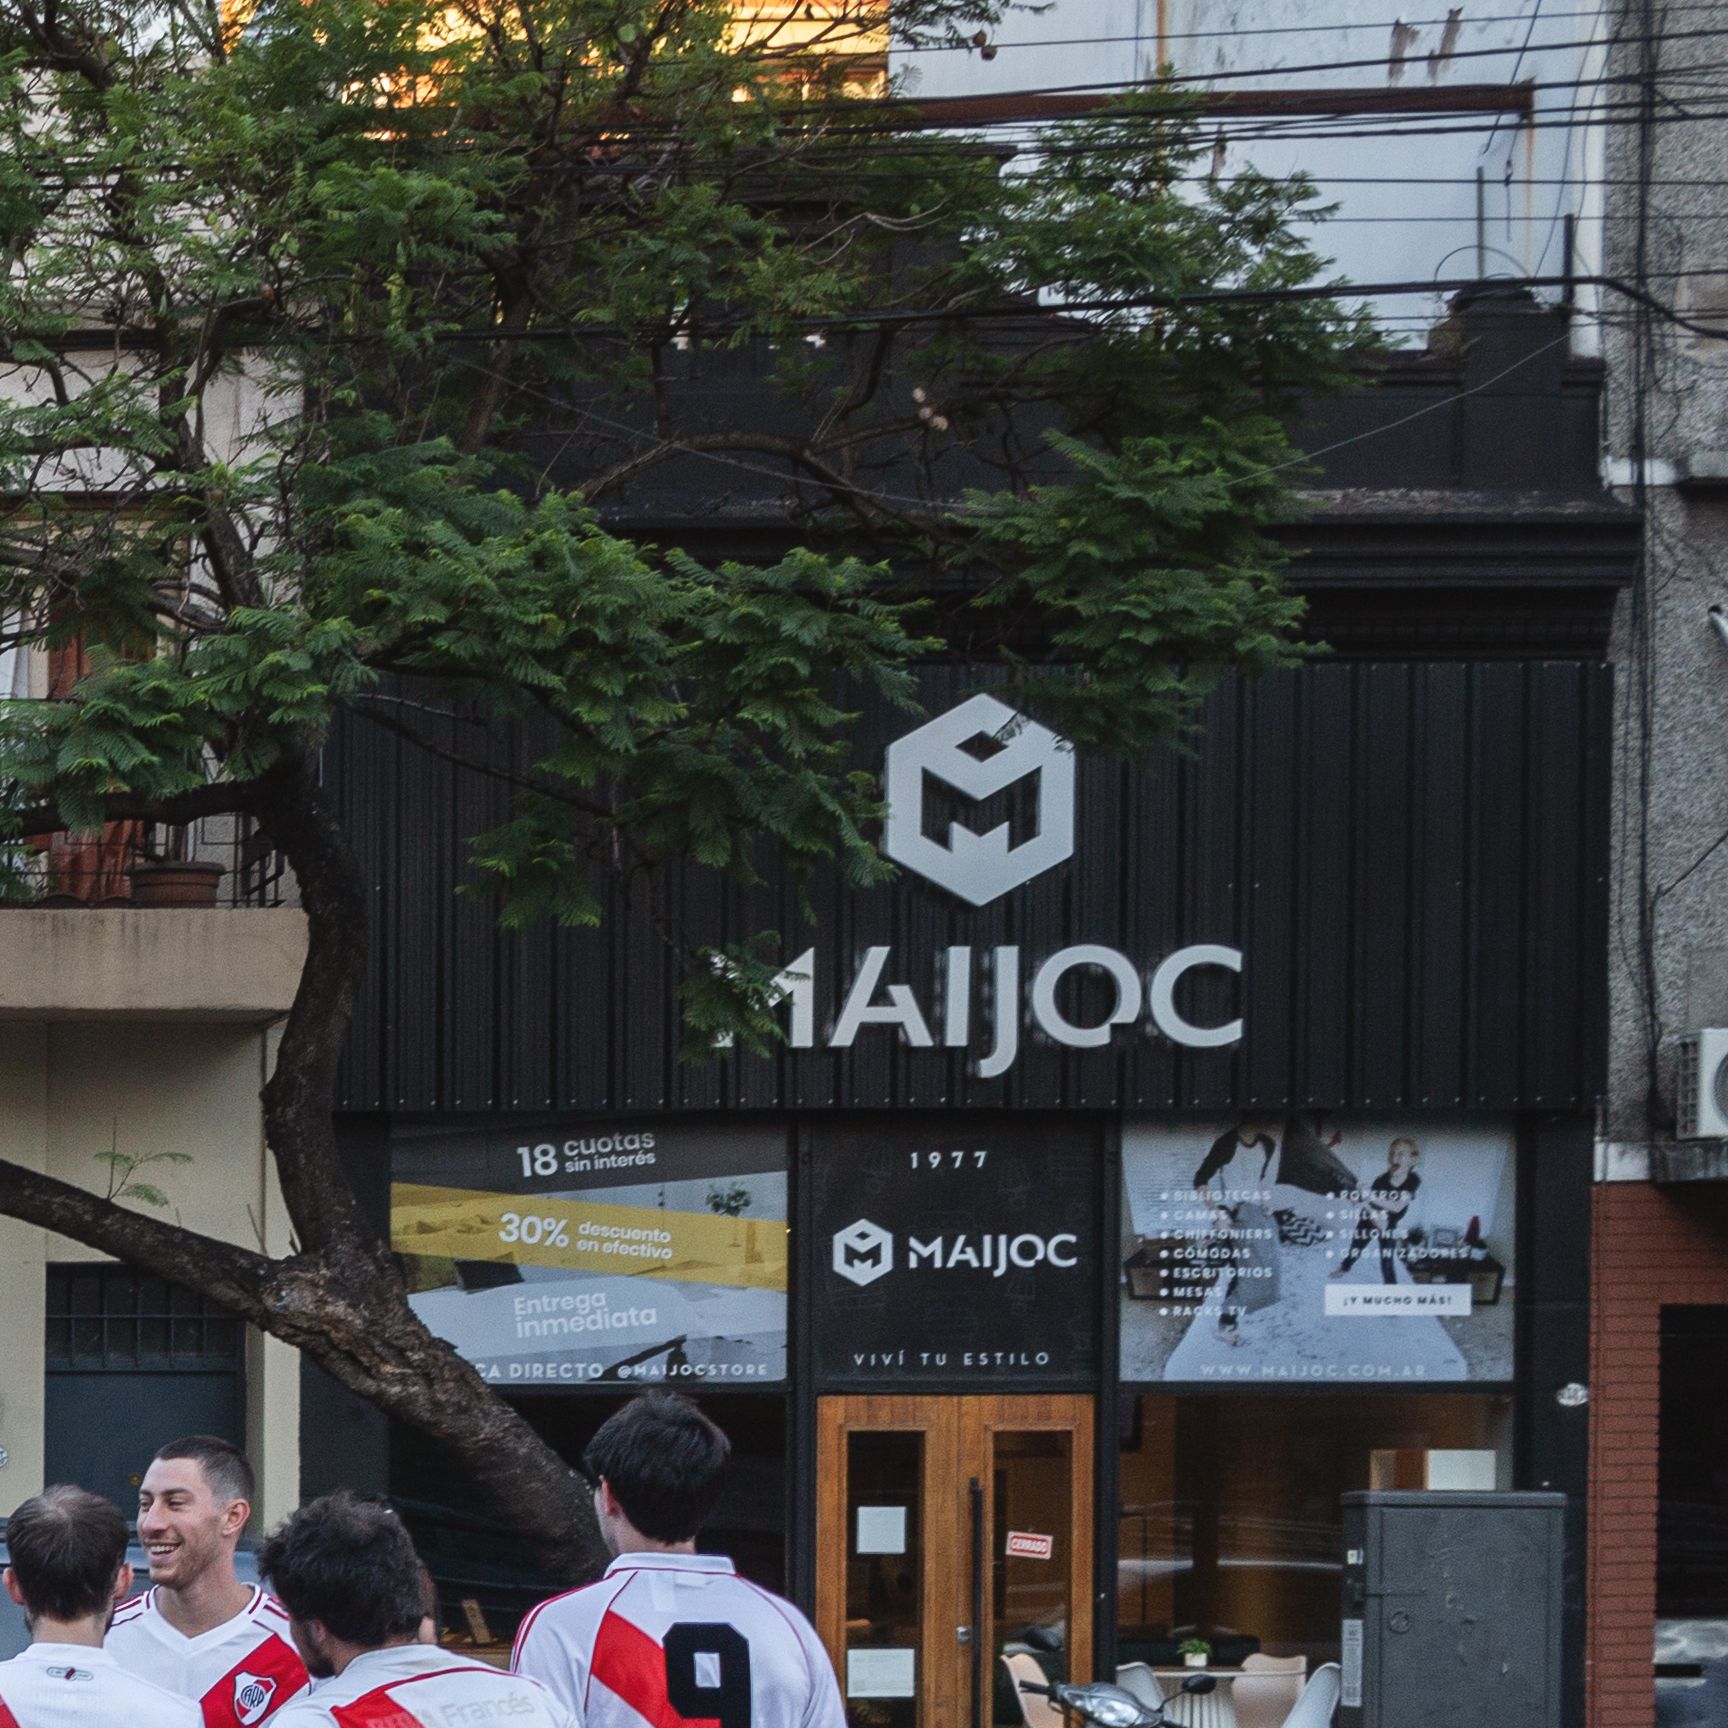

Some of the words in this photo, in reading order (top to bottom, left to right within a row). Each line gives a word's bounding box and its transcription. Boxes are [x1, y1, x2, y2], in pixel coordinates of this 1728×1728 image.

[517, 1144, 558, 1178] 18
[563, 1132, 656, 1158] cuotas
[564, 1158, 590, 1174] sin
[593, 1150, 656, 1171] interés
[910, 1151, 987, 1169] 1977
[1173, 1189, 1272, 1201] BIBLIOTECAS
[1339, 1190, 1410, 1201] ROPEROS
[1174, 1209, 1228, 1221] CAMAS
[1339, 1209, 1389, 1220] SILLAS
[498, 1211, 570, 1249] 30%
[578, 1220, 672, 1244] descuento
[576, 1238, 599, 1253] en
[601, 1240, 673, 1260] efectivo
[908, 1233, 1078, 1278] MAIJOC
[1172, 1266, 1273, 1279] ESCRITORIOS
[1172, 1286, 1224, 1298] MESAS
[1362, 1295, 1413, 1305] MUCHO
[1417, 1293, 1452, 1305] MÁS!
[514, 1291, 607, 1317] Entrega
[1228, 1305, 1248, 1317] TV
[515, 1306, 657, 1339] inmediata
[854, 1350, 904, 1366] VIVÍ
[920, 1352, 947, 1366] TU
[963, 1351, 1050, 1366] ESTILO
[508, 1362, 604, 1379] DIRECTO
[616, 1362, 768, 1379] @MAIJOCSTORE
